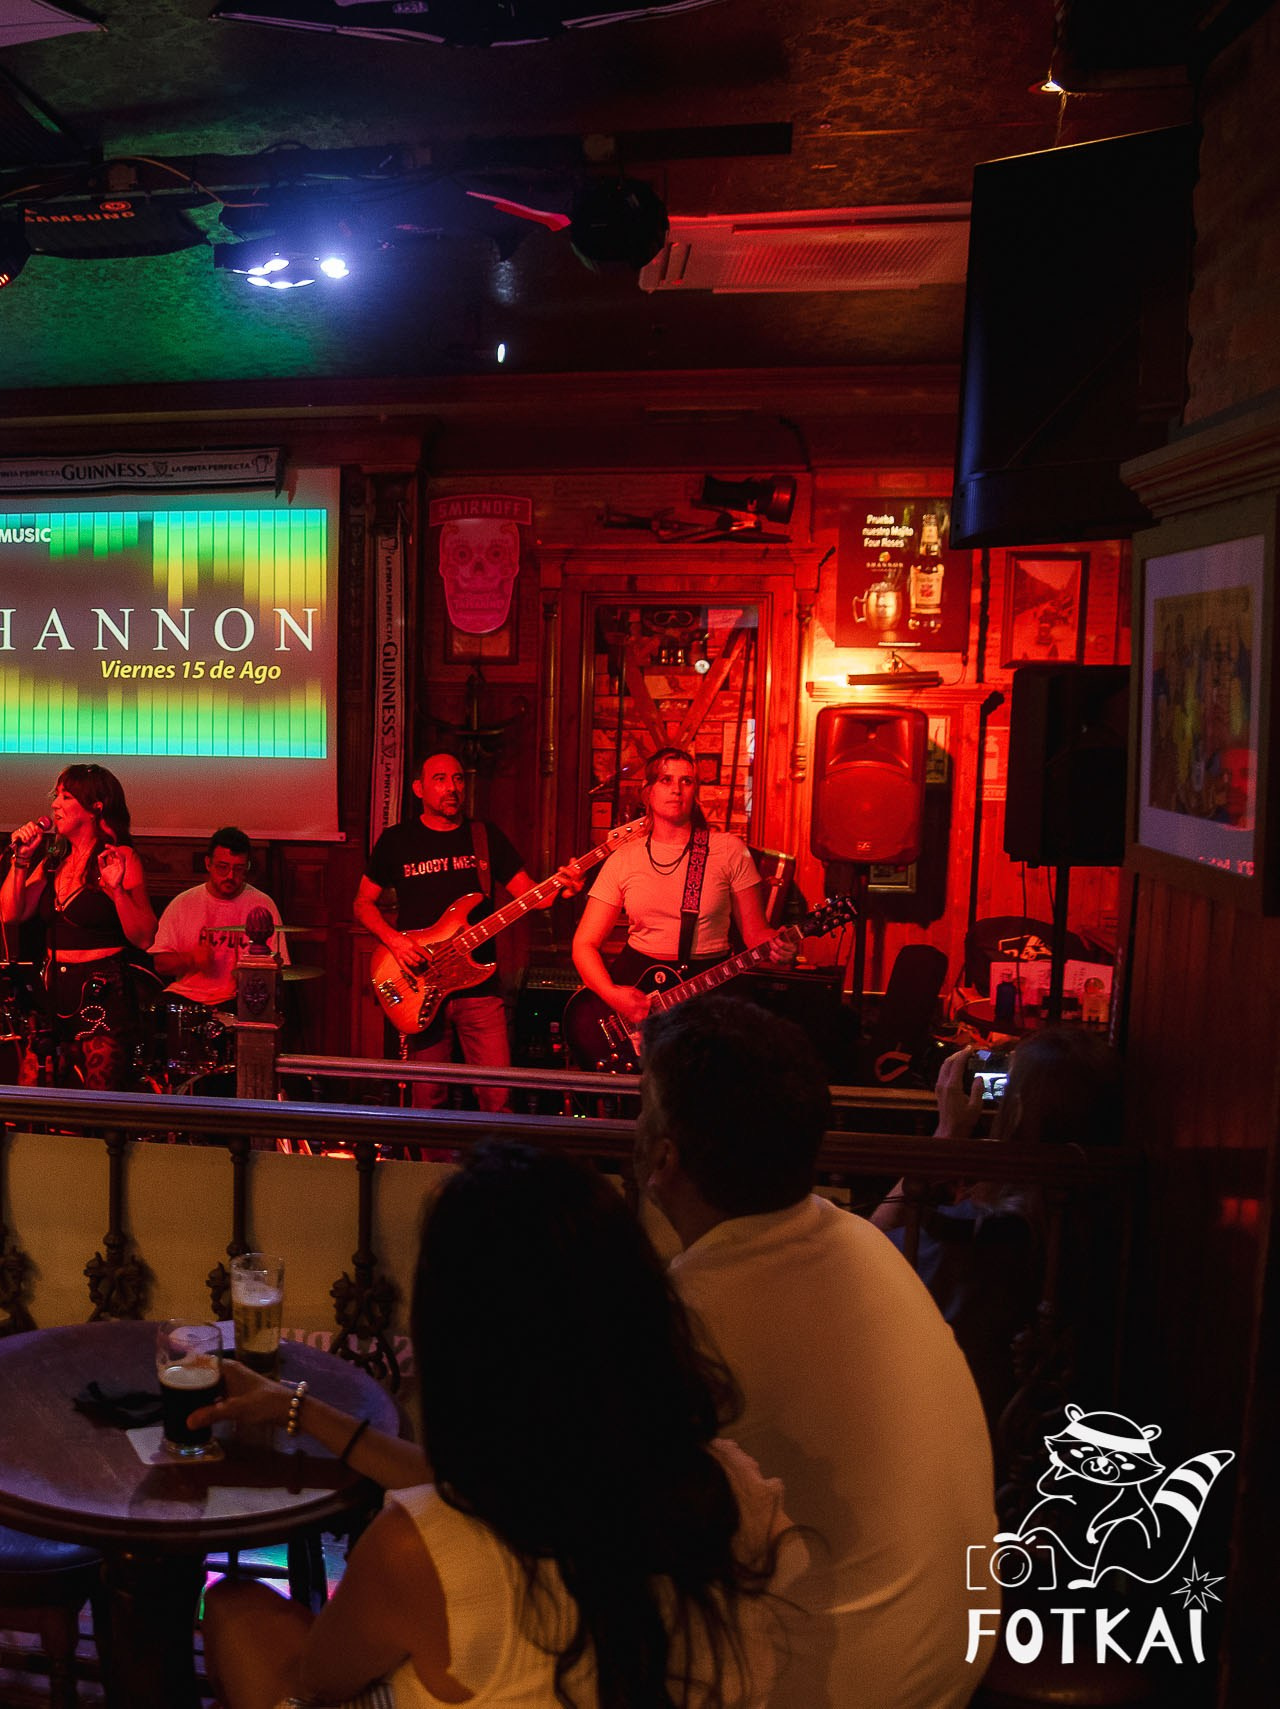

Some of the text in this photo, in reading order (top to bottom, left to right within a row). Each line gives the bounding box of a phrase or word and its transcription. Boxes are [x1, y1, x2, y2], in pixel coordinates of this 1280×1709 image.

[20, 469, 60, 478] PERFECTA
[61, 463, 146, 481] GUINNESS
[209, 462, 250, 471] PERFECTA
[439, 500, 521, 517] SMIRNOFF
[101, 660, 282, 684] Viernes 15 de Ago
[382, 641, 398, 736] GUINNESS
[403, 857, 449, 878] BLOODY
